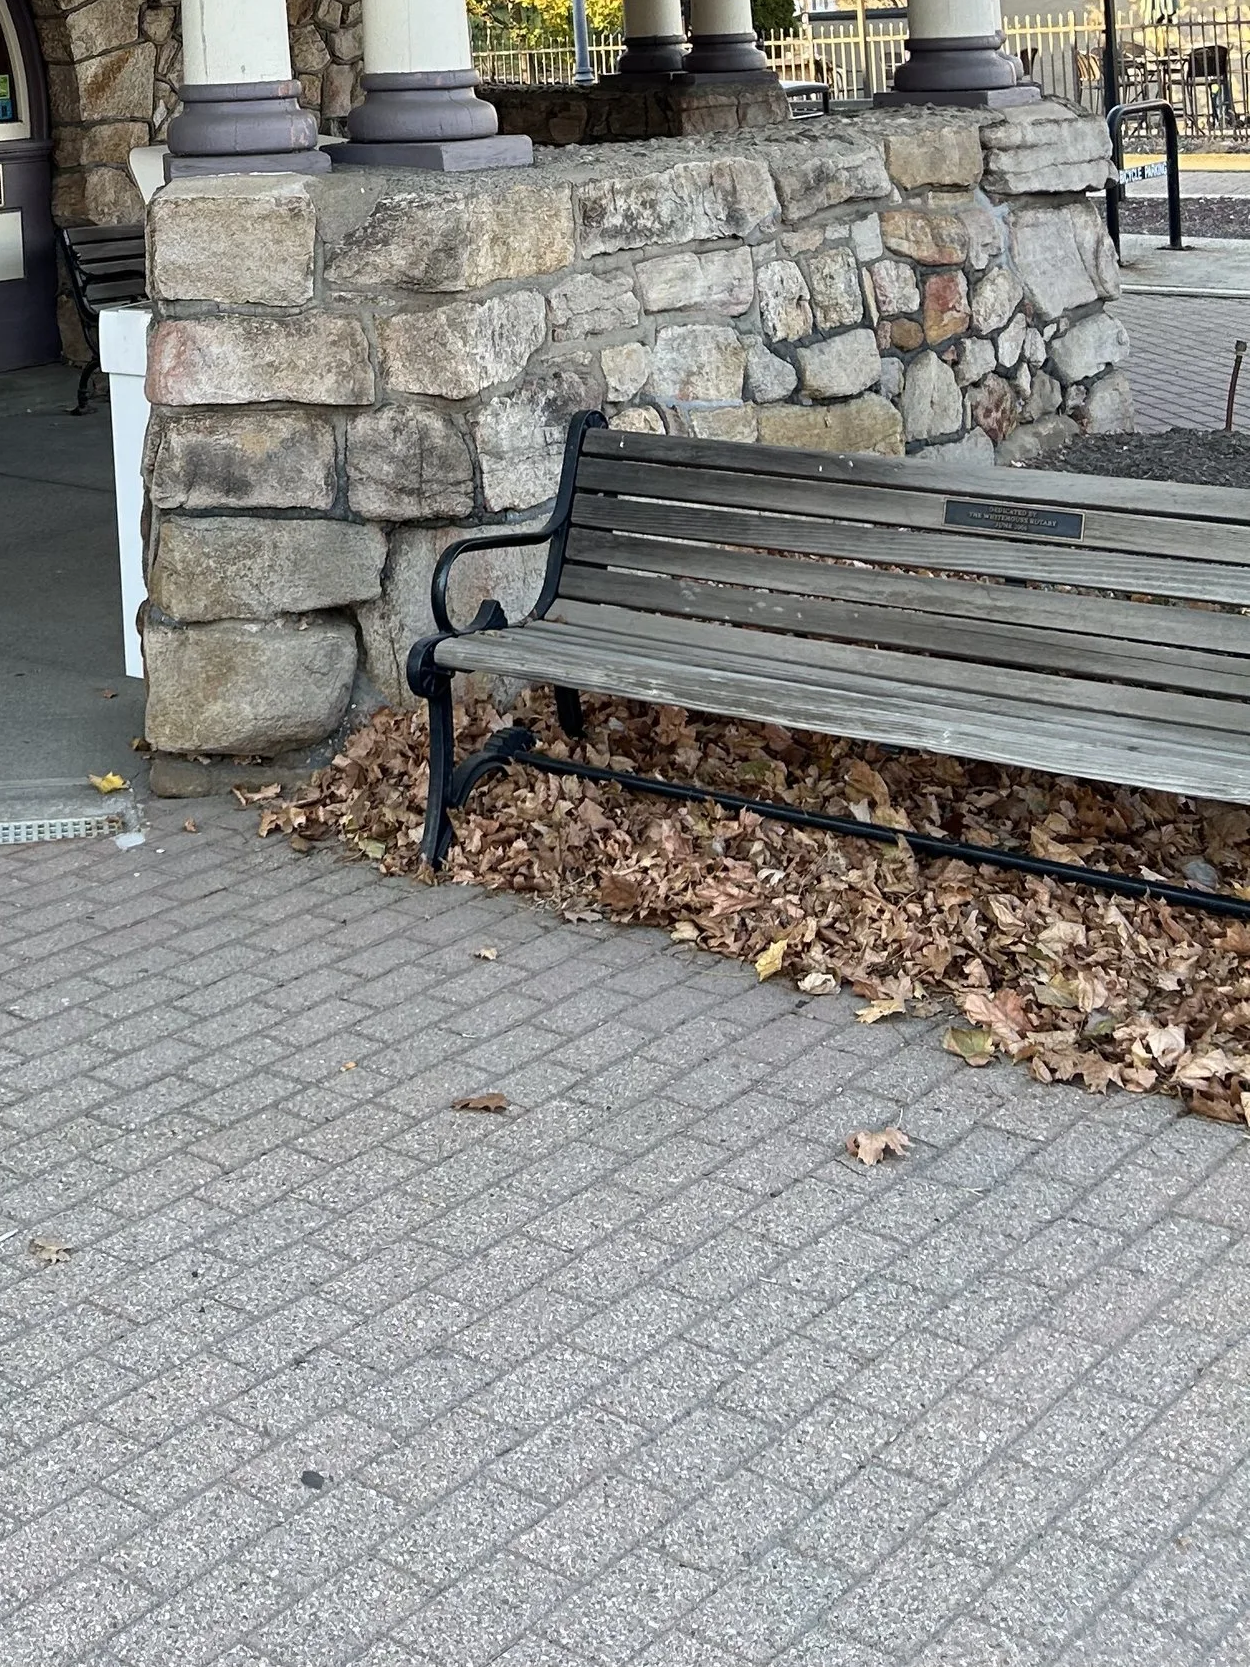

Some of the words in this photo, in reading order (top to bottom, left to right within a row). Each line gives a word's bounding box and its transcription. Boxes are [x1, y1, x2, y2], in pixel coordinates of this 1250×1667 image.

[1119, 167, 1143, 184] BICYCLE
[1145, 162, 1167, 178] PARKING
[989, 506, 1026, 516] DEDICATED
